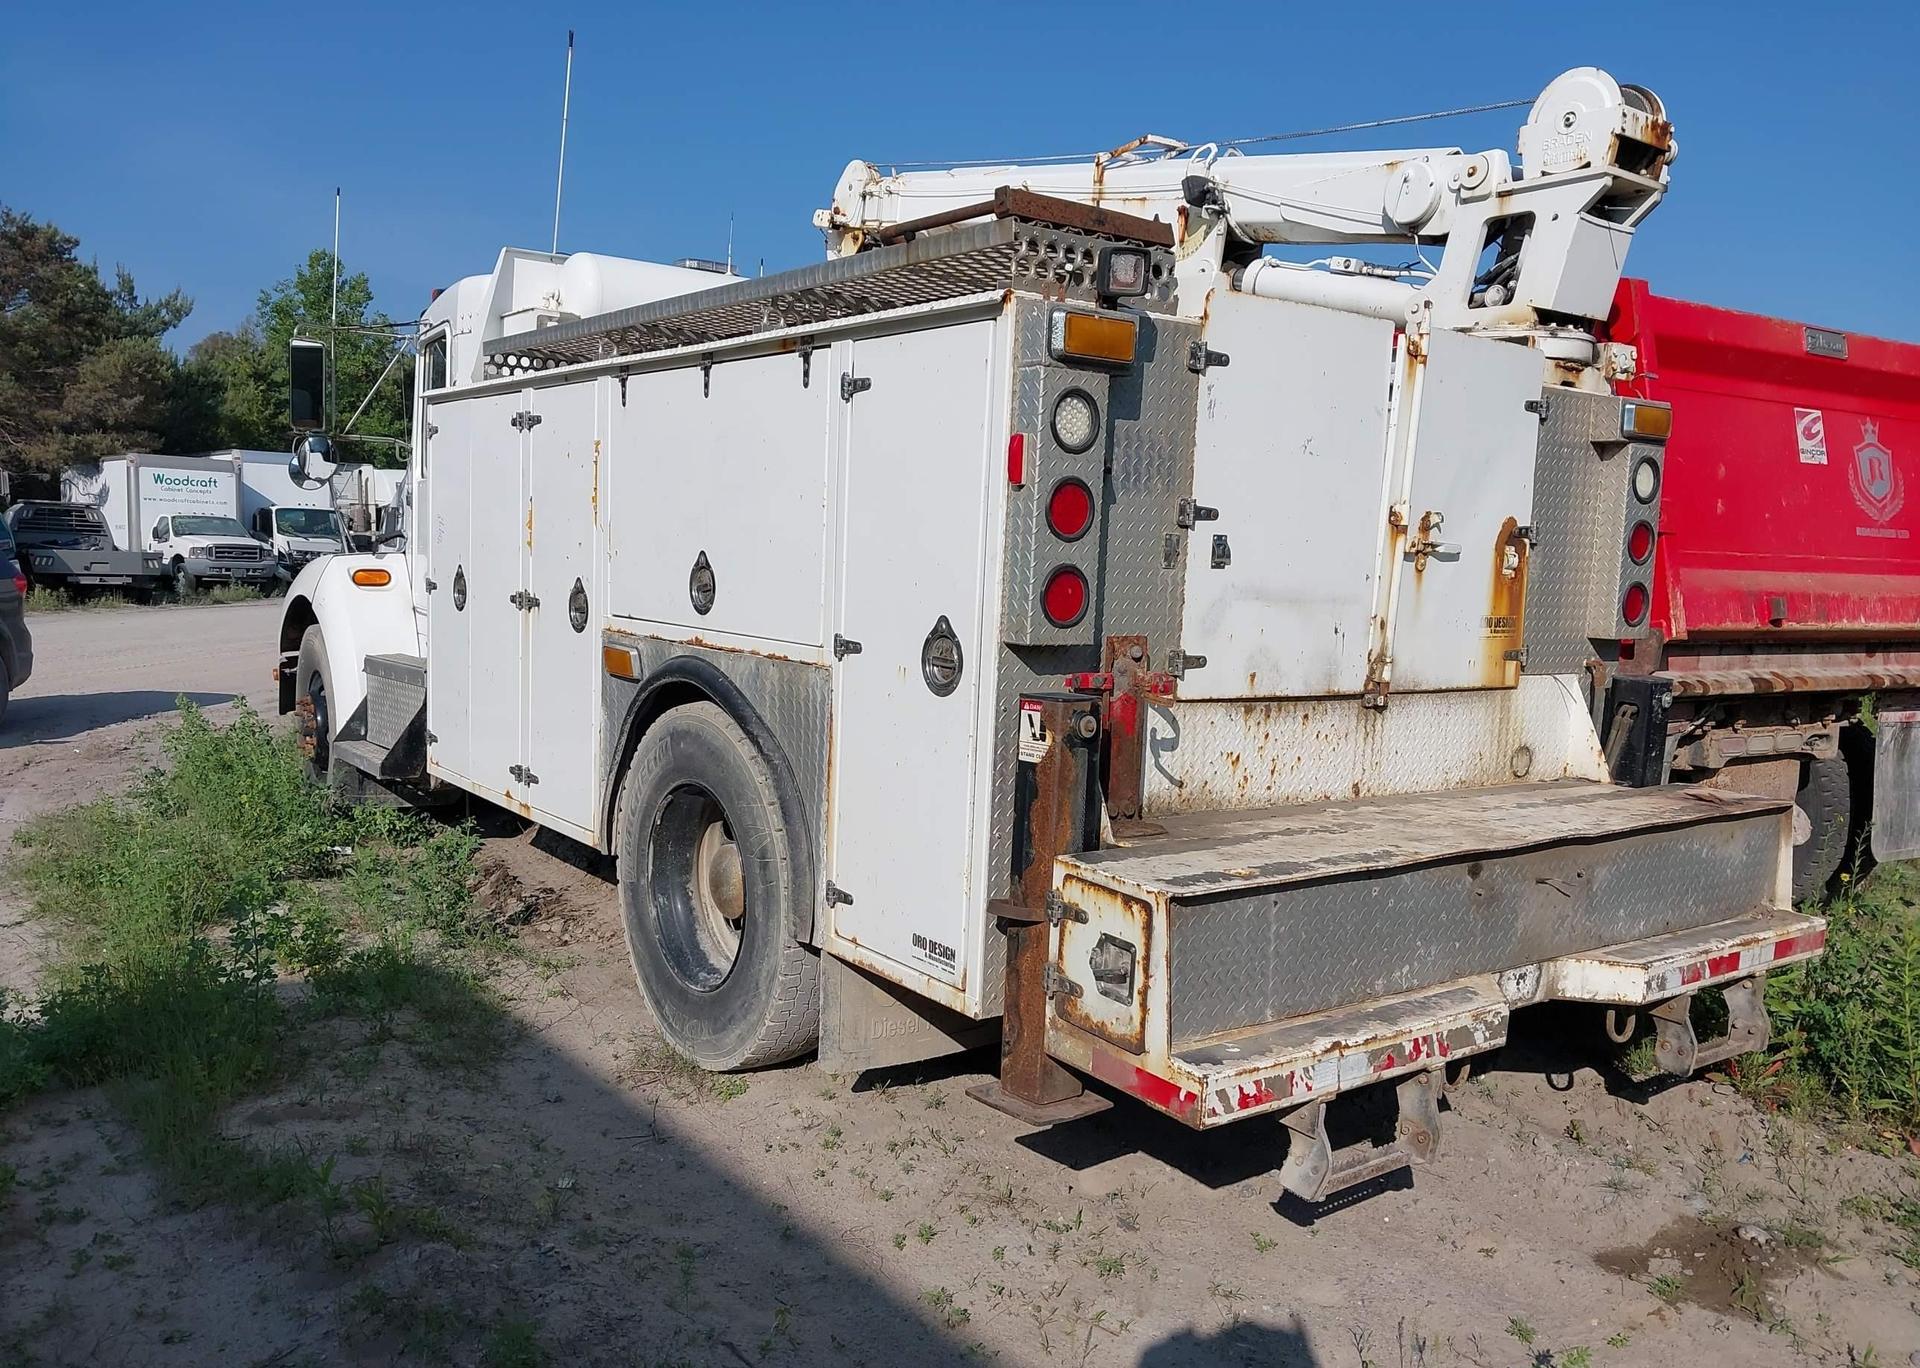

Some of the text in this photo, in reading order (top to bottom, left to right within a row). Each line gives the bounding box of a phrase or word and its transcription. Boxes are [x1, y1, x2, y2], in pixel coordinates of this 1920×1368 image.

[153, 473, 218, 488] Woodcraft
[186, 487, 212, 495] Concepts
[912, 932, 956, 963] ORO DESIGN
[872, 1016, 920, 1039] Diesel
